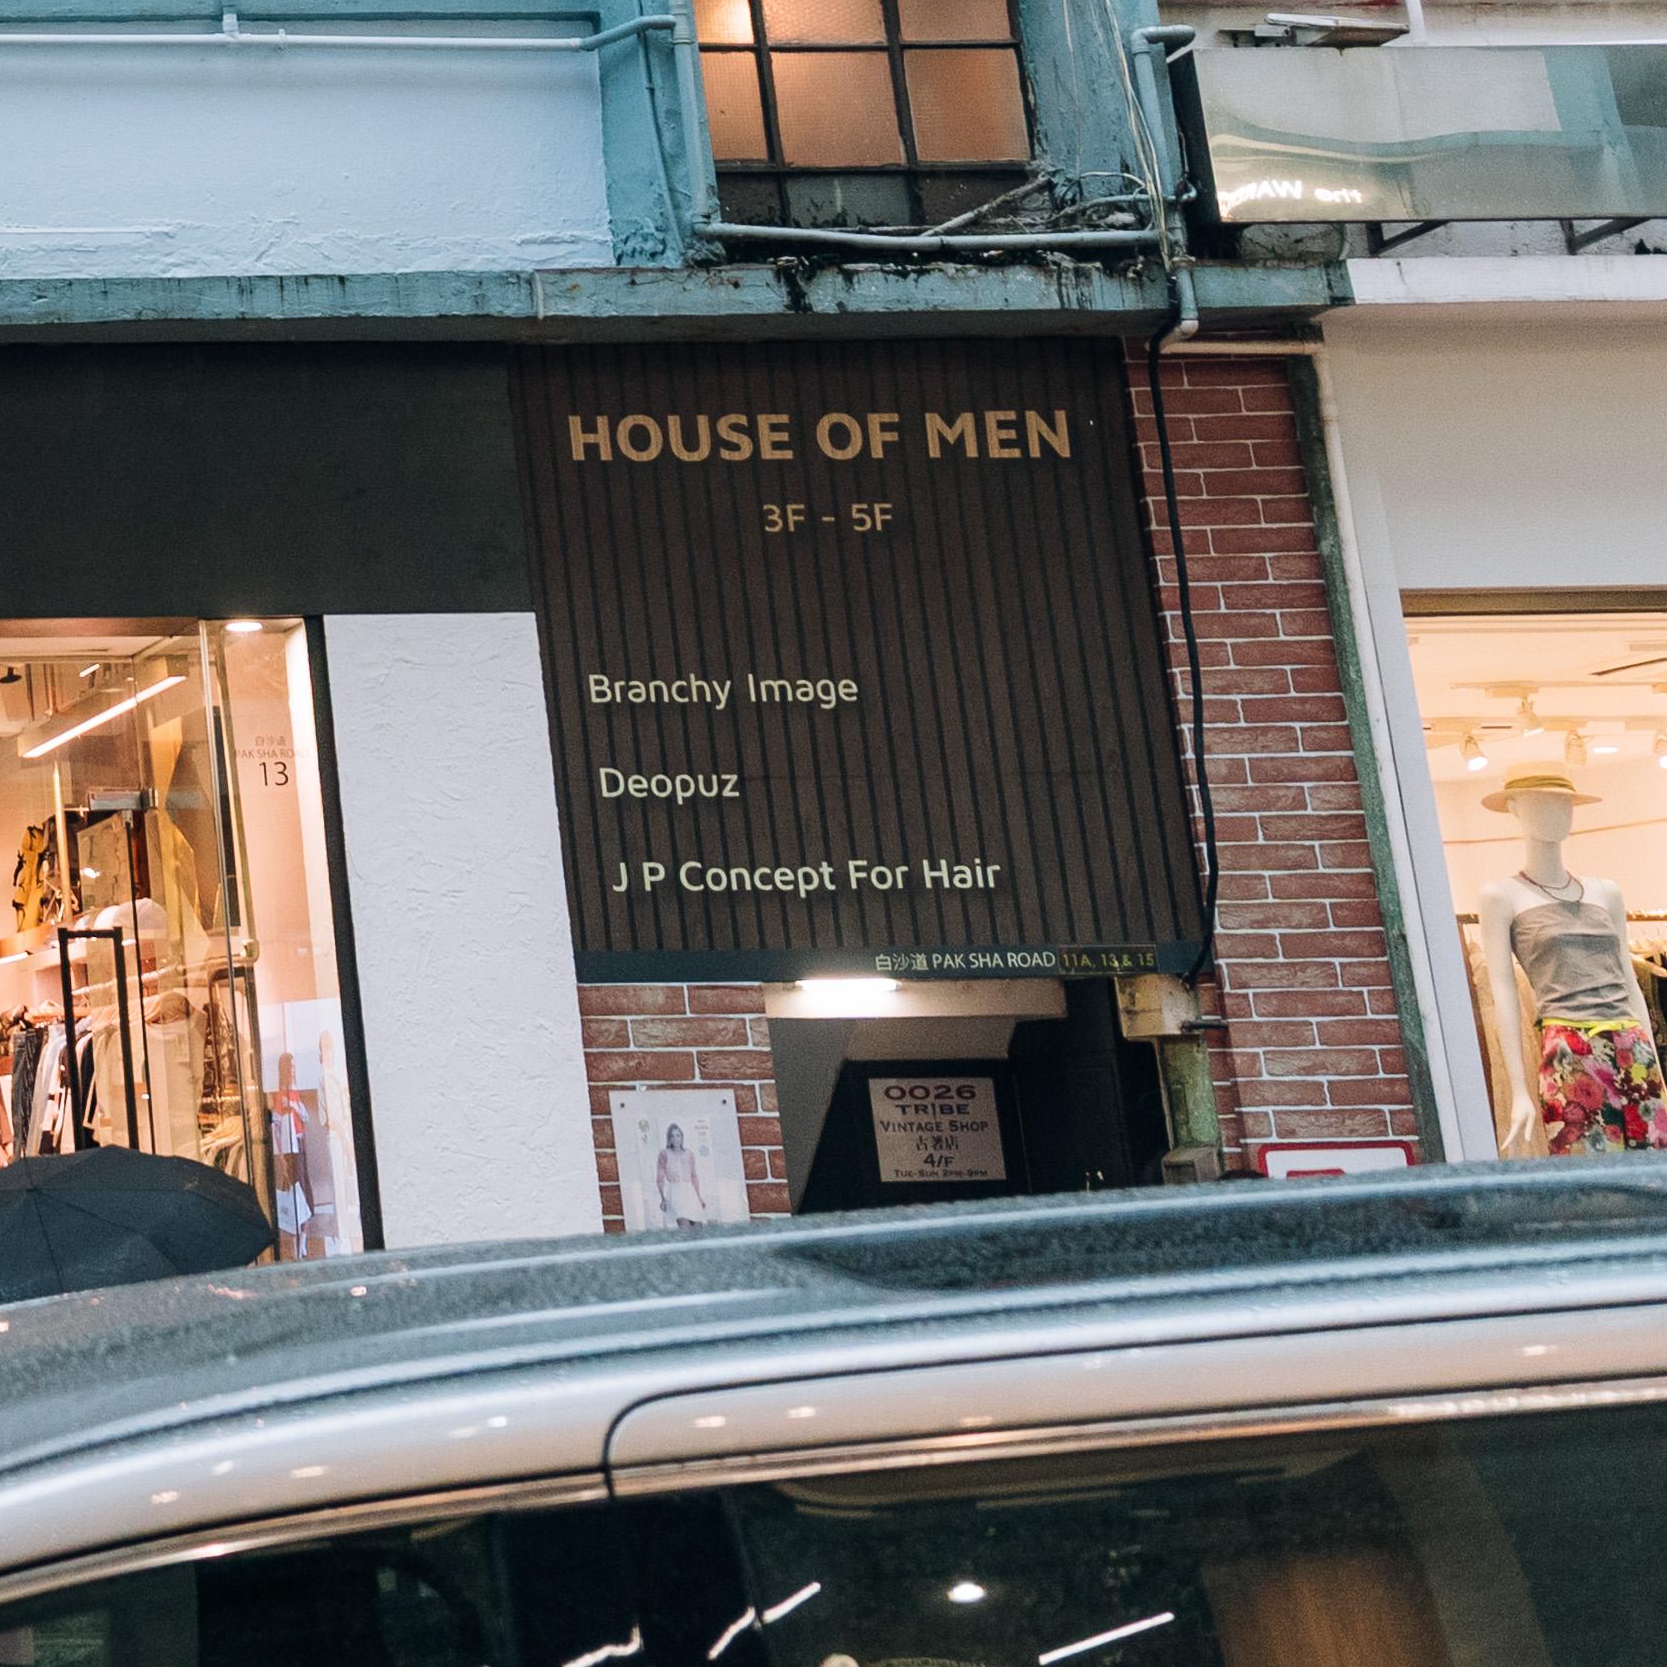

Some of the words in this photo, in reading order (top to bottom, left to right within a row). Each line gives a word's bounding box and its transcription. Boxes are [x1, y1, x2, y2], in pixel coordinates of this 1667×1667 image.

[567, 413, 795, 463] HOUSE
[816, 412, 901, 460] OF
[926, 409, 1072, 459] MEN
[762, 503, 806, 533] 3F
[850, 502, 893, 532] 5F
[587, 673, 733, 710] Branchy
[748, 673, 859, 710] Image
[259, 761, 289, 787] 13
[598, 766, 741, 805] Deopuz
[611, 862, 629, 894] J
[643, 861, 666, 893] P
[678, 859, 837, 899] Concept
[848, 859, 909, 891] For
[923, 856, 1002, 890] Hair
[875, 953, 928, 972] 白沙道
[932, 952, 966, 969] PAK
[968, 952, 1004, 969] SHA
[1007, 951, 1057, 968] ROAD
[1138, 952, 1156, 967] 15
[894, 1102, 971, 1117] TRIBE
[923, 1153, 956, 1168] 4/F
